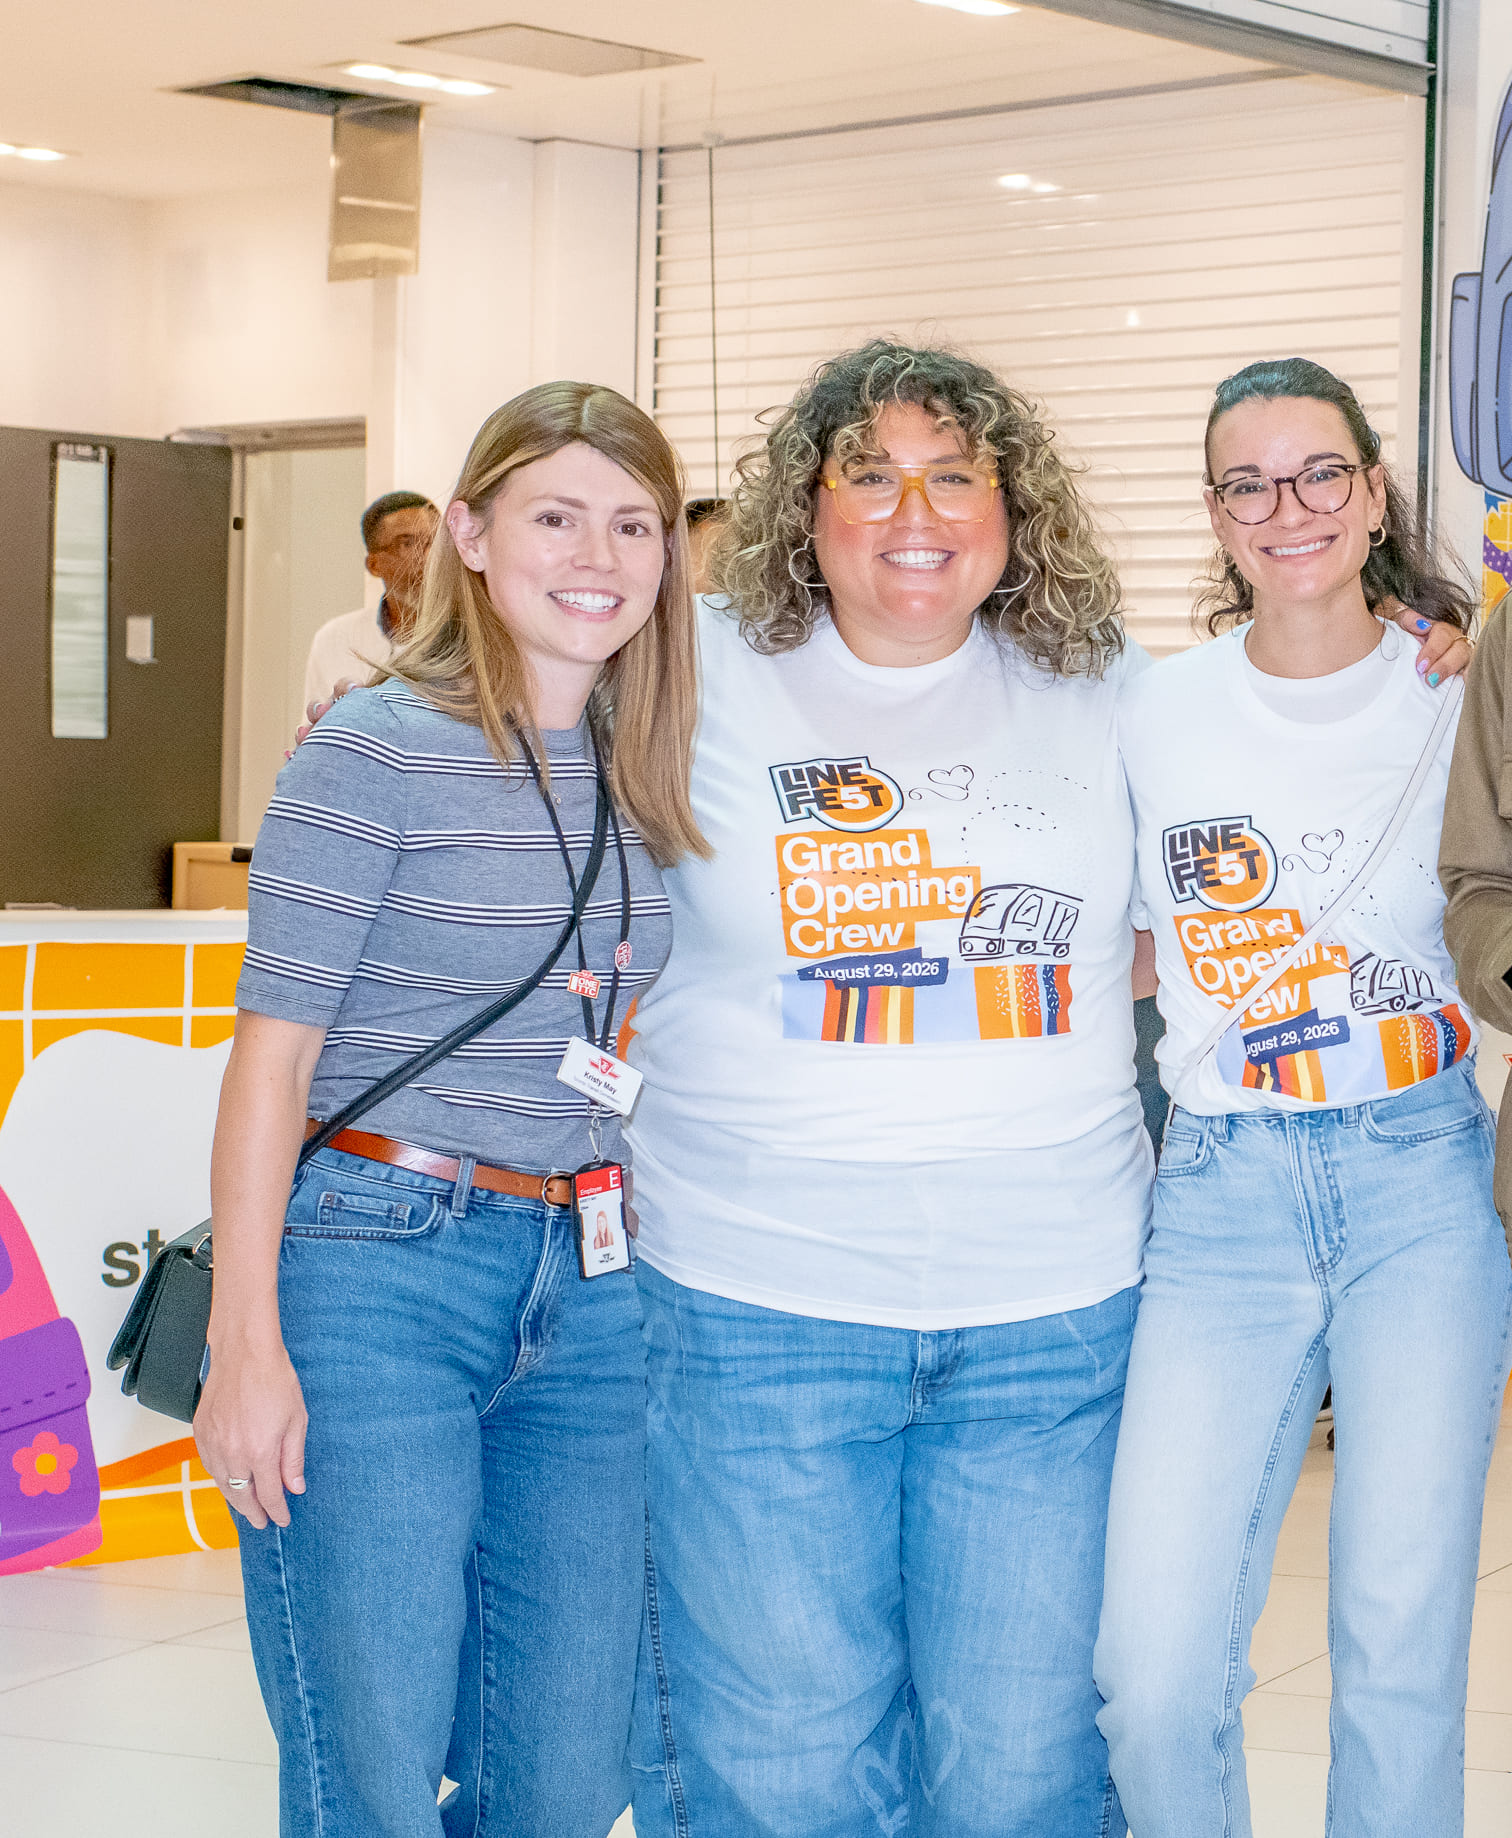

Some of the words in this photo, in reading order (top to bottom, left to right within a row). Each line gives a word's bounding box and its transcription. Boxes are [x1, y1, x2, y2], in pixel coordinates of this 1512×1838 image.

[778, 762, 869, 793] LINE
[782, 833, 921, 874] Grand
[1168, 822, 1246, 863] LINE
[786, 869, 974, 924] Opening
[789, 918, 905, 954] Crew
[578, 978, 598, 988] ONE
[873, 963, 898, 979] 29,
[901, 961, 940, 977] 2026
[578, 986, 597, 996] TTC
[1280, 1030, 1301, 1046] 29,
[1303, 1021, 1340, 1041] 2026
[609, 1169, 620, 1189] E
[102, 1229, 166, 1288] st
